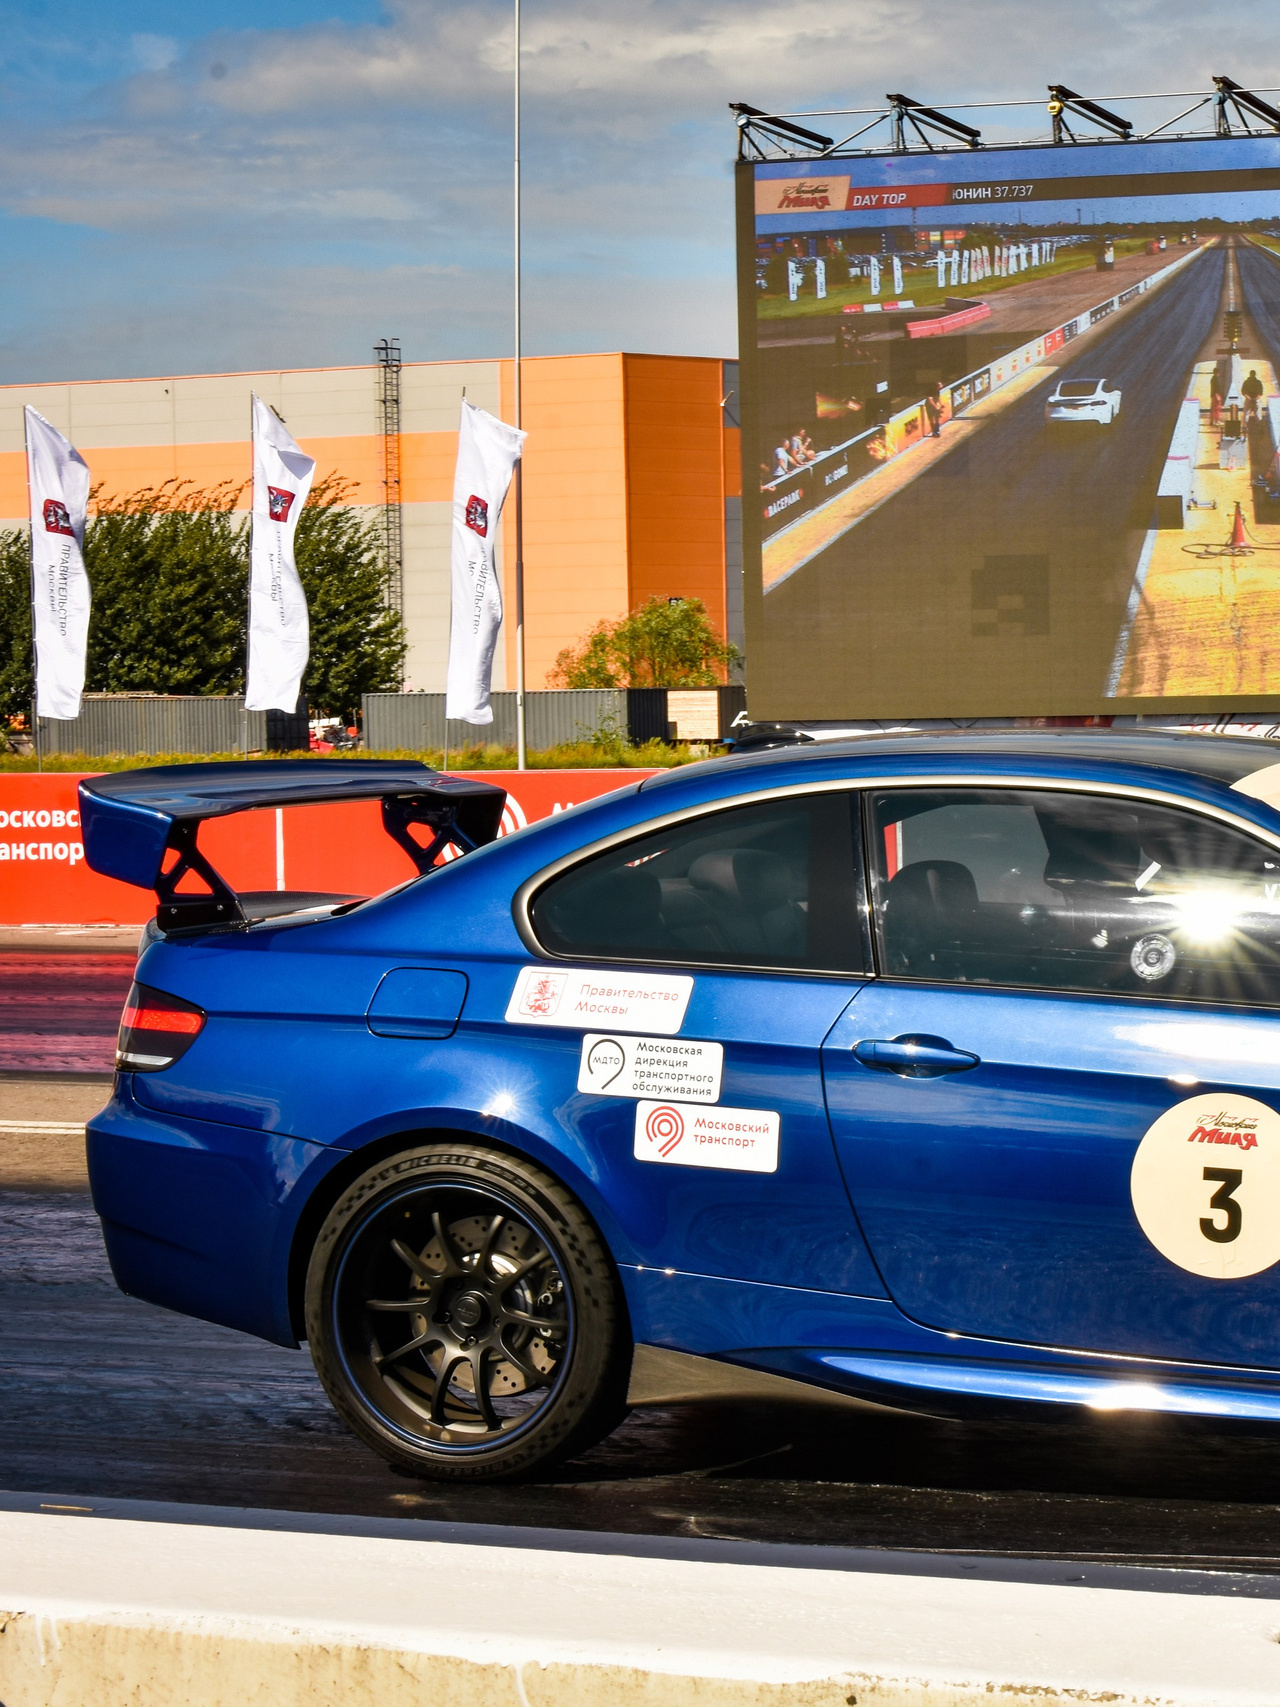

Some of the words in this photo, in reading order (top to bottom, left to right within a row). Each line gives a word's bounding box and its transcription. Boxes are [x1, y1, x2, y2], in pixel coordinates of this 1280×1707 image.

[994, 185, 1034, 198] 37.737
[853, 194, 879, 207] DAY
[882, 193, 907, 206] TOP
[0, 809, 81, 828] осковс
[0, 842, 85, 866] анспор
[580, 984, 679, 1002] Правительство
[575, 1001, 629, 1015] Москвы
[636, 1042, 703, 1056] Московская
[635, 1056, 689, 1068] дирекция
[633, 1070, 714, 1083] транспортного
[632, 1081, 712, 1097] обслуживания
[694, 1117, 770, 1134] Московский
[693, 1133, 756, 1149] транспорт
[1199, 1166, 1243, 1243] 3
